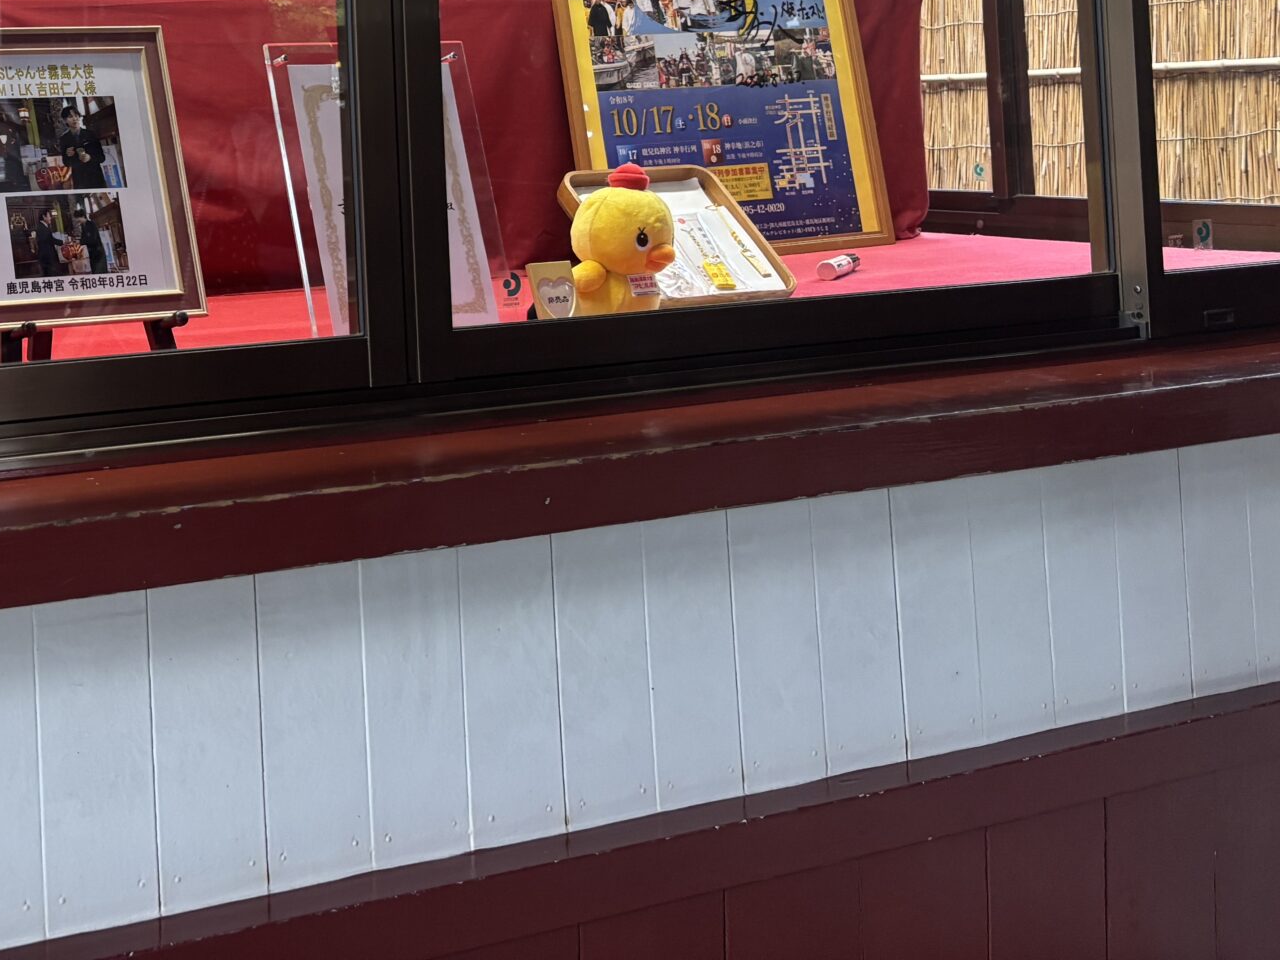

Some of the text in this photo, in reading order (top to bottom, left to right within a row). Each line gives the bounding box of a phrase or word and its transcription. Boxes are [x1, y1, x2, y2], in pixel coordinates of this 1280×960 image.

[35, 80, 97, 96] 吉田仁人様
[610, 106, 673, 136] 10/17
[6, 274, 148, 295] 鹿児島神宮 令和8年8月22日
